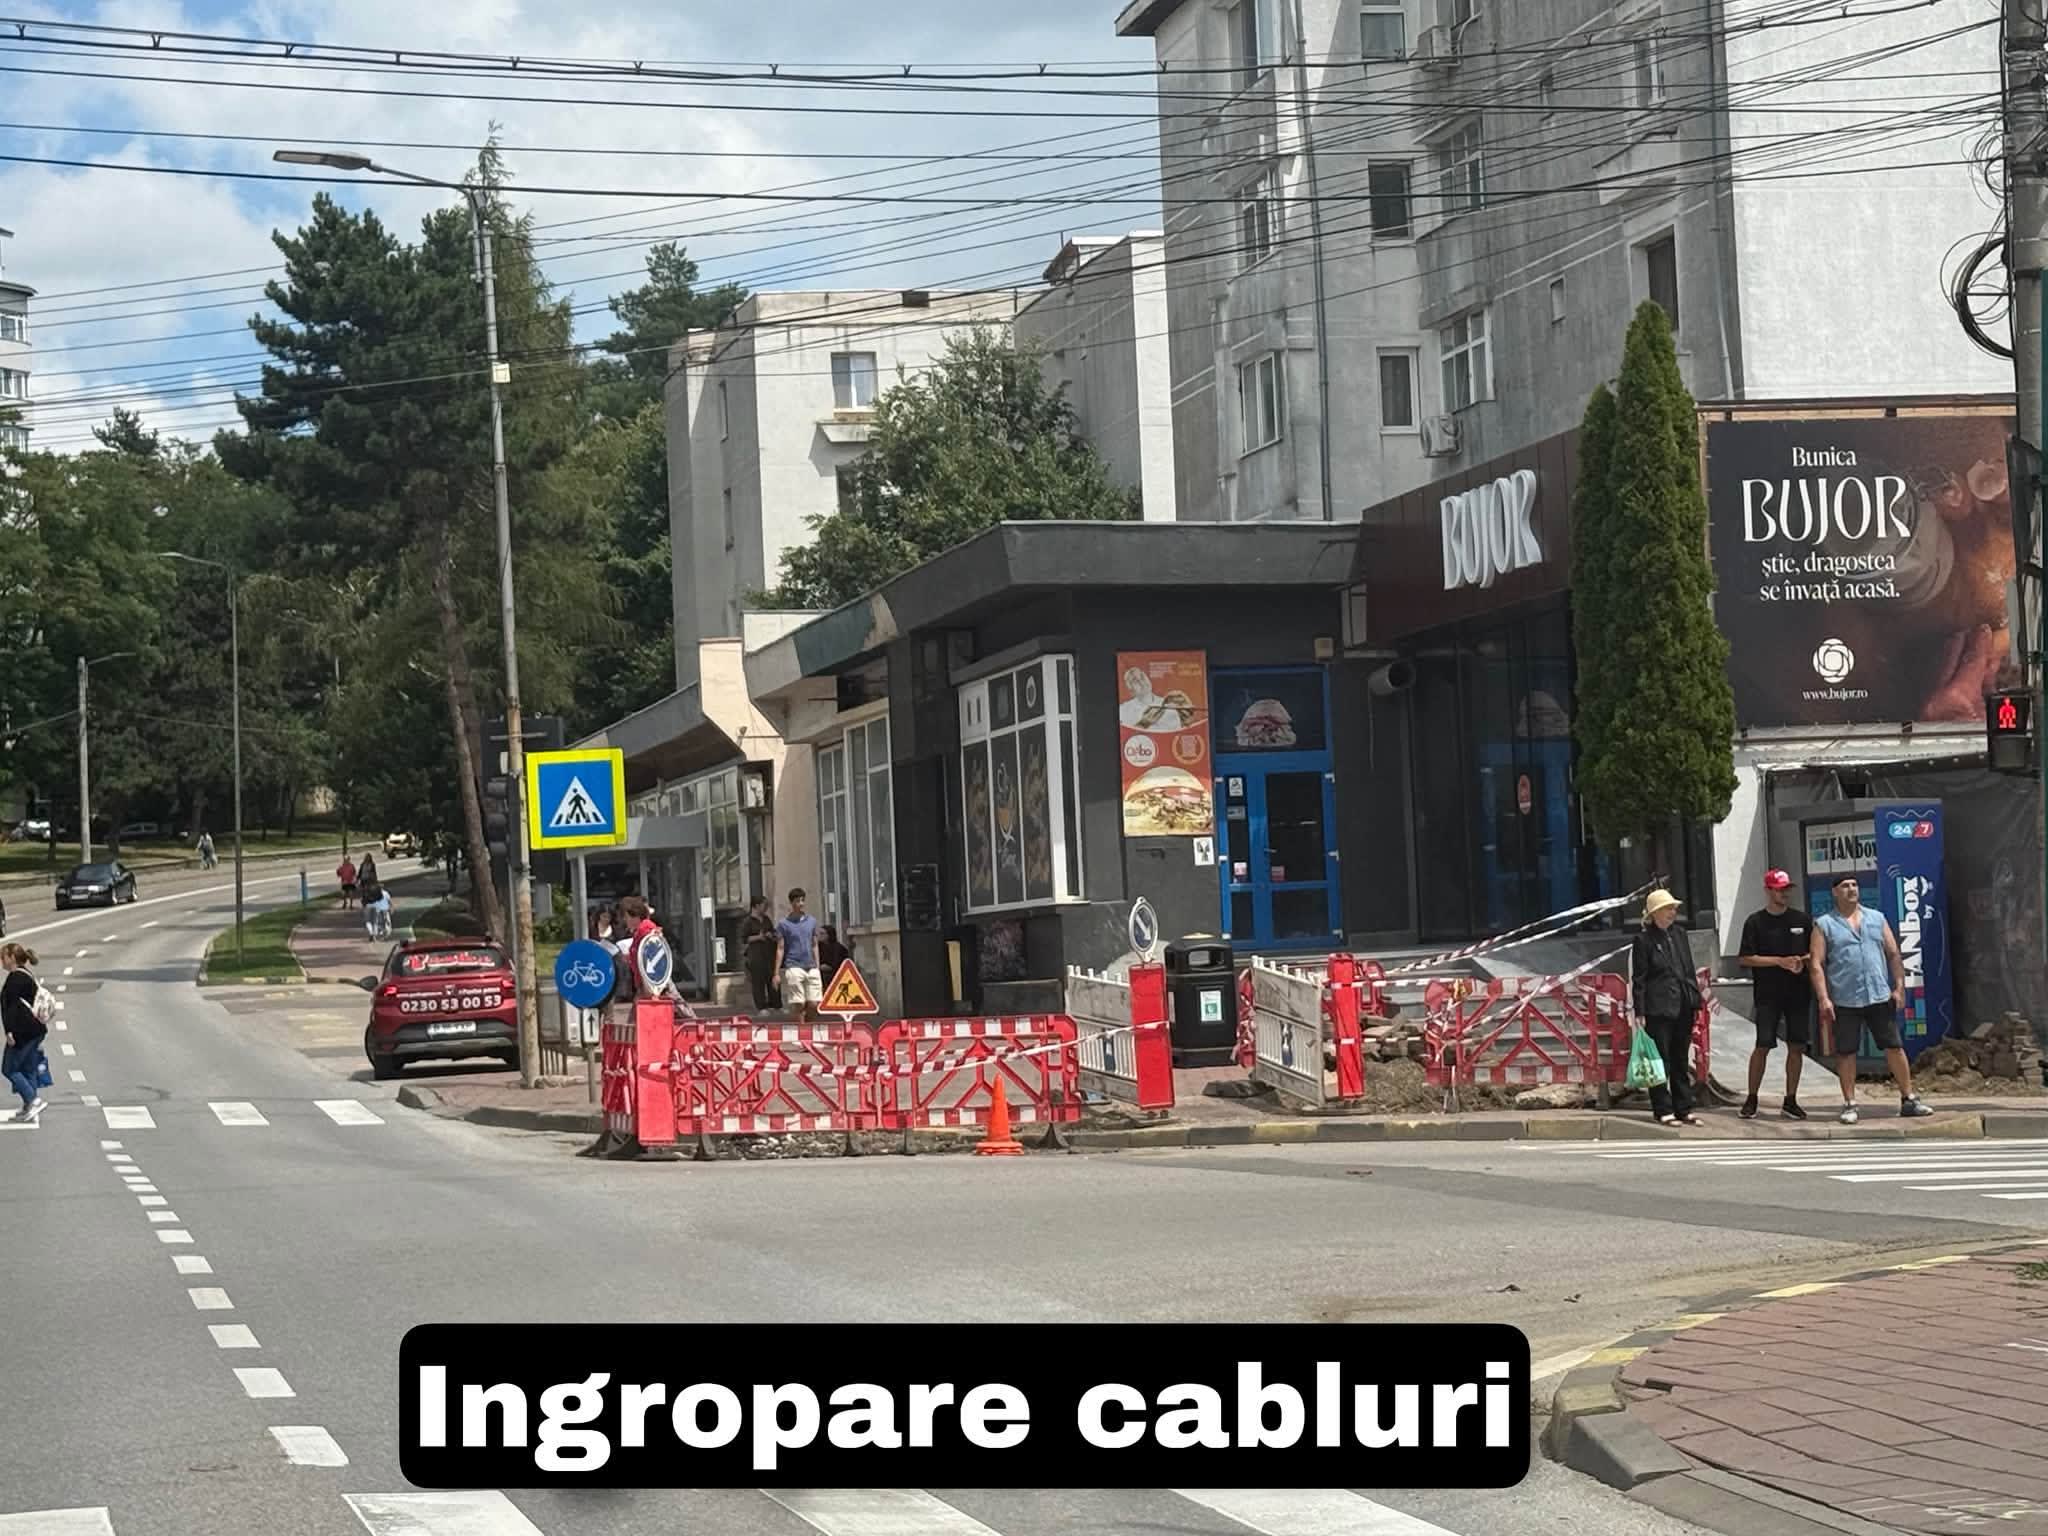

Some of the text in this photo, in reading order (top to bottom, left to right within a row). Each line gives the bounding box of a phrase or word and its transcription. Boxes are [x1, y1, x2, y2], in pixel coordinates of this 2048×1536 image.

[1792, 446, 1857, 467] Bunica
[1742, 476, 1911, 545] BUJOR
[1440, 469, 1542, 590] BUJOR
[1804, 551, 1896, 576] dragostea
[1760, 584, 1780, 600] se
[1844, 578, 1901, 599] acasă.
[1802, 687, 1868, 701] www.bujor.ro
[1899, 876, 1924, 988] FANbox
[401, 994, 501, 1012] 0230 53 00 53
